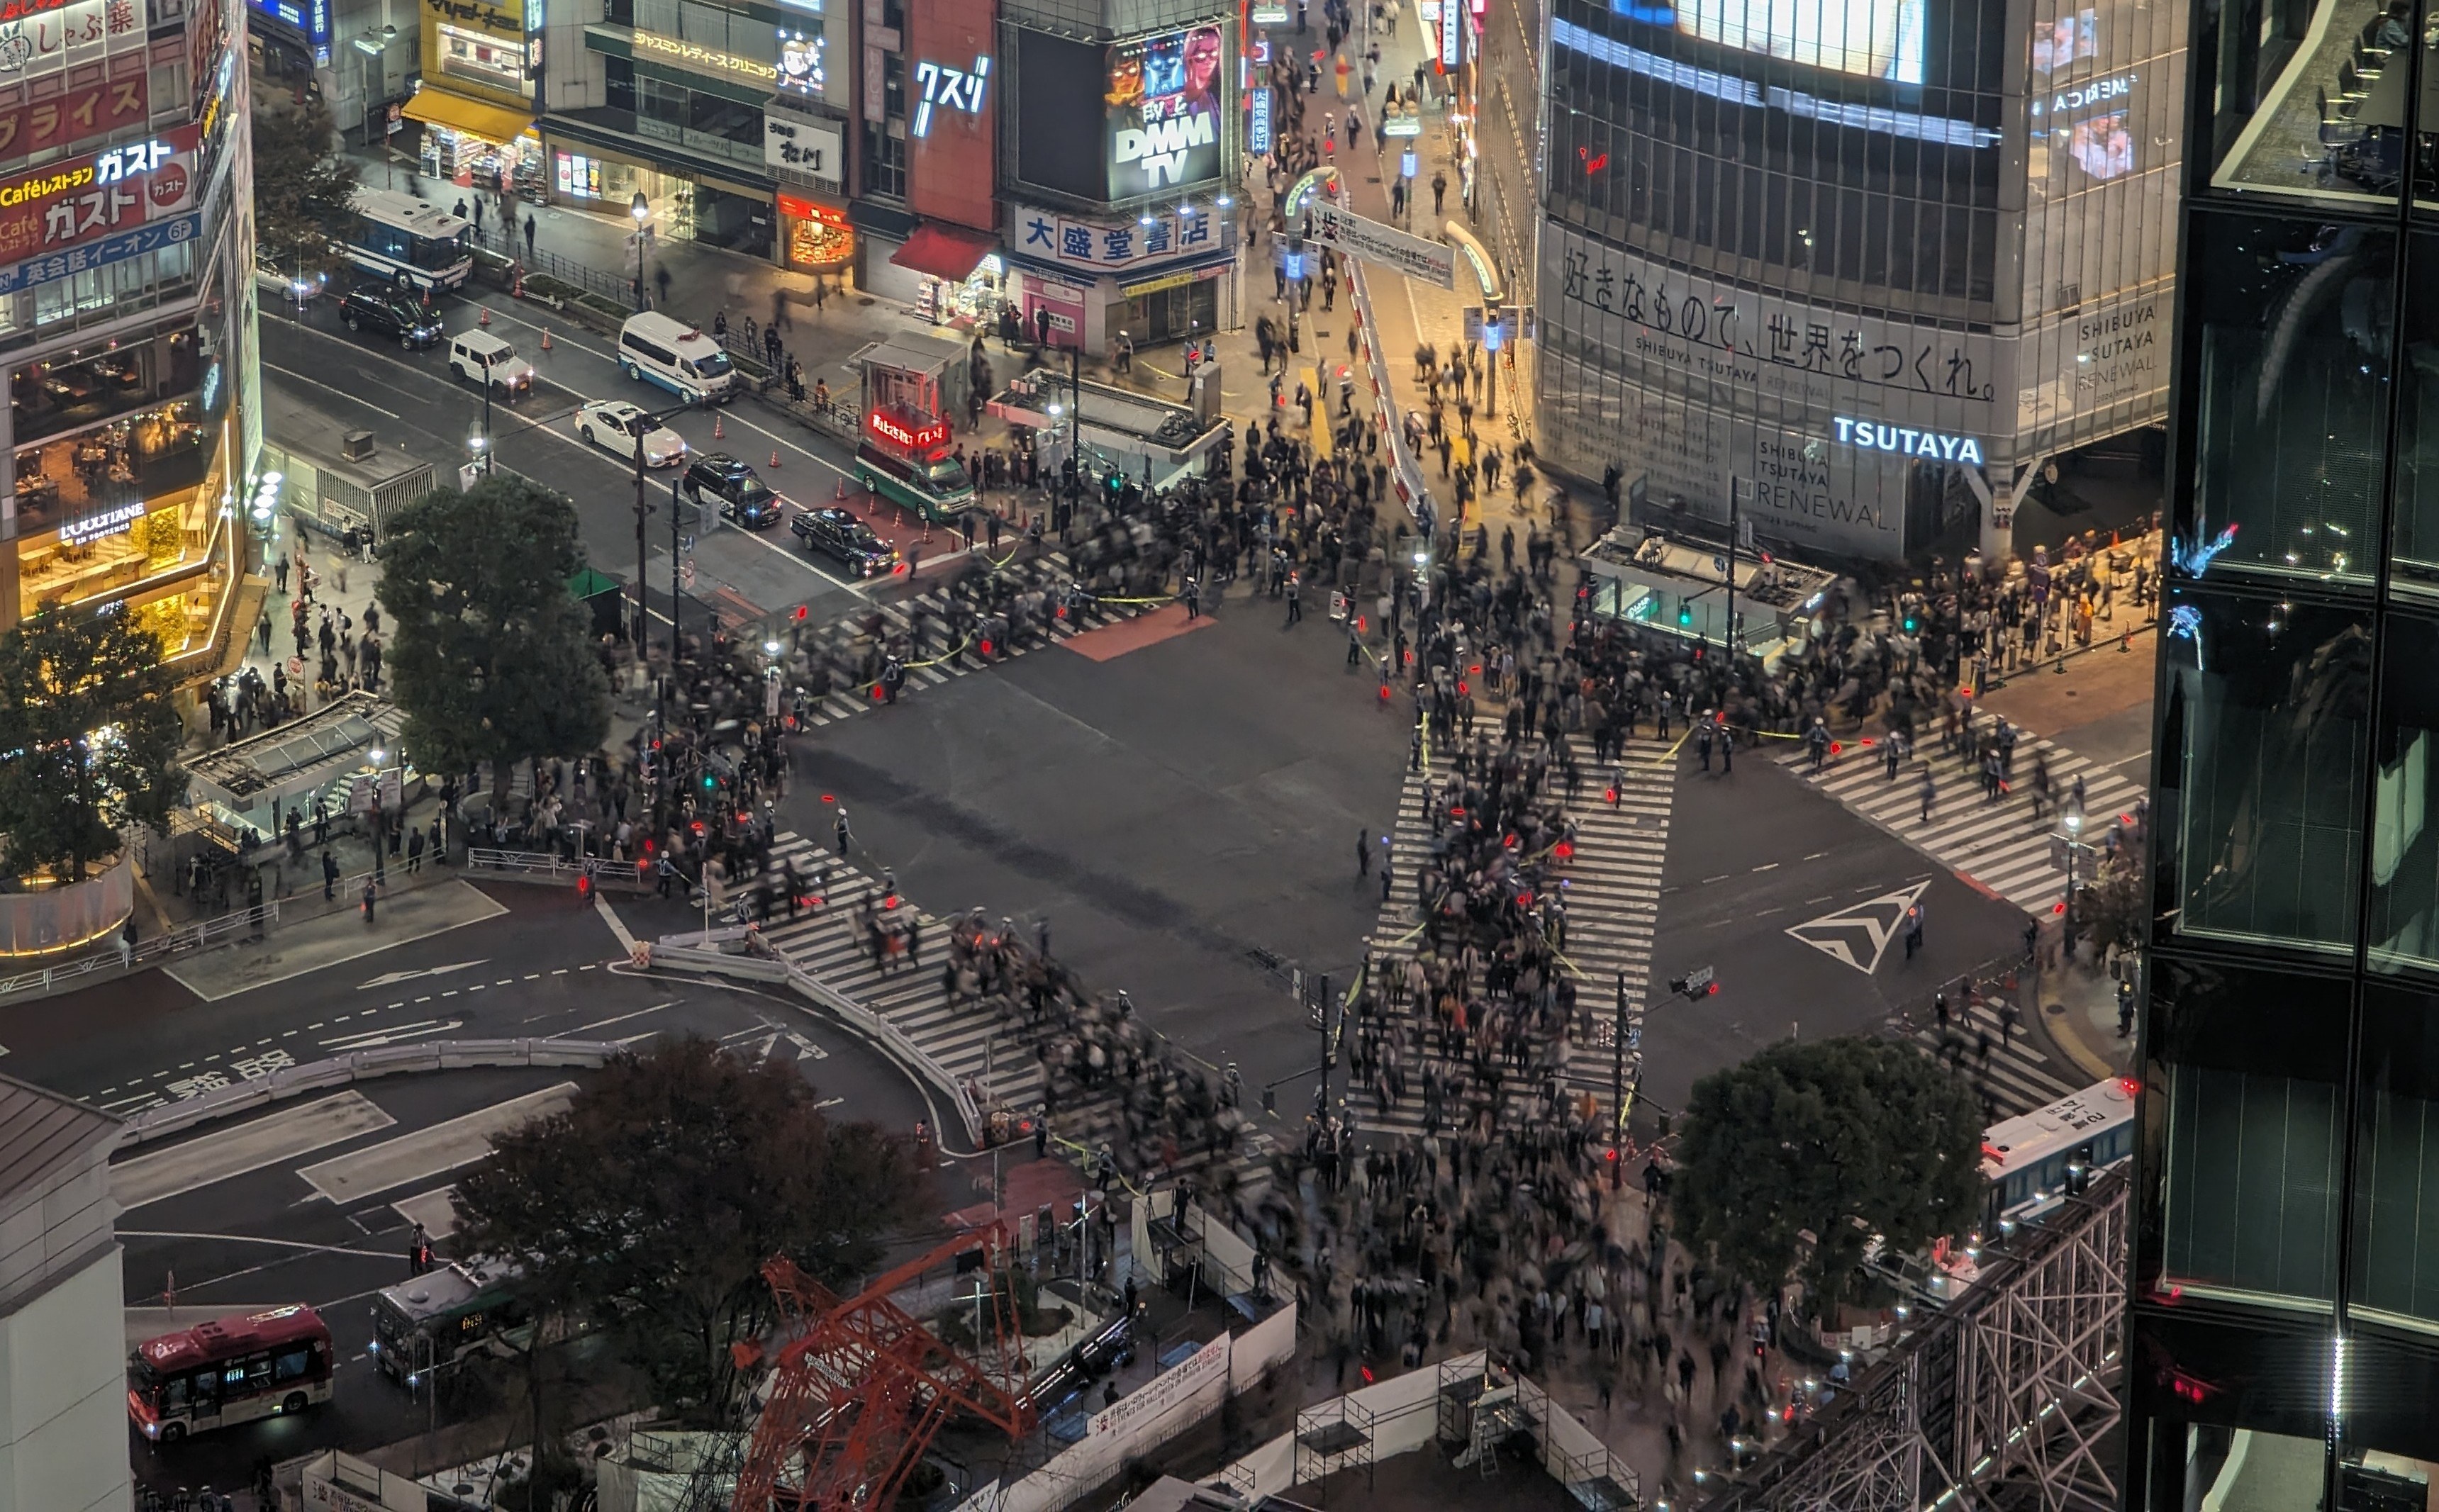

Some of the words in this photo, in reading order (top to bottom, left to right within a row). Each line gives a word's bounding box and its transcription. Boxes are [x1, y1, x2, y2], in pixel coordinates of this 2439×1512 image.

[40, 1, 134, 53] しゃぶ葉
[635, 33, 681, 53] ジャスミン
[681, 45, 727, 68] レディース
[730, 57, 776, 79] クリニック
[914, 55, 988, 138] クスリ
[1116, 111, 1213, 163] DMM
[98, 140, 171, 185] ガスト
[1142, 149, 1188, 188] TV
[153, 179, 184, 196] ガスト
[45, 186, 135, 245] ガスト
[1026, 212, 1210, 260] 大盛堂書店
[26, 231, 161, 285] 英会話イーオン
[170, 225, 187, 240] 6F
[1564, 247, 1994, 402] 好きなもので、世界をつくれ。
[2082, 306, 2155, 340] SHIBUYA
[1636, 337, 1692, 366] SHIBUYA
[1699, 357, 1758, 382] TSUTAYA
[1834, 416, 1983, 465] TSUTAYA
[1761, 461, 1827, 487] TSUTAYA
